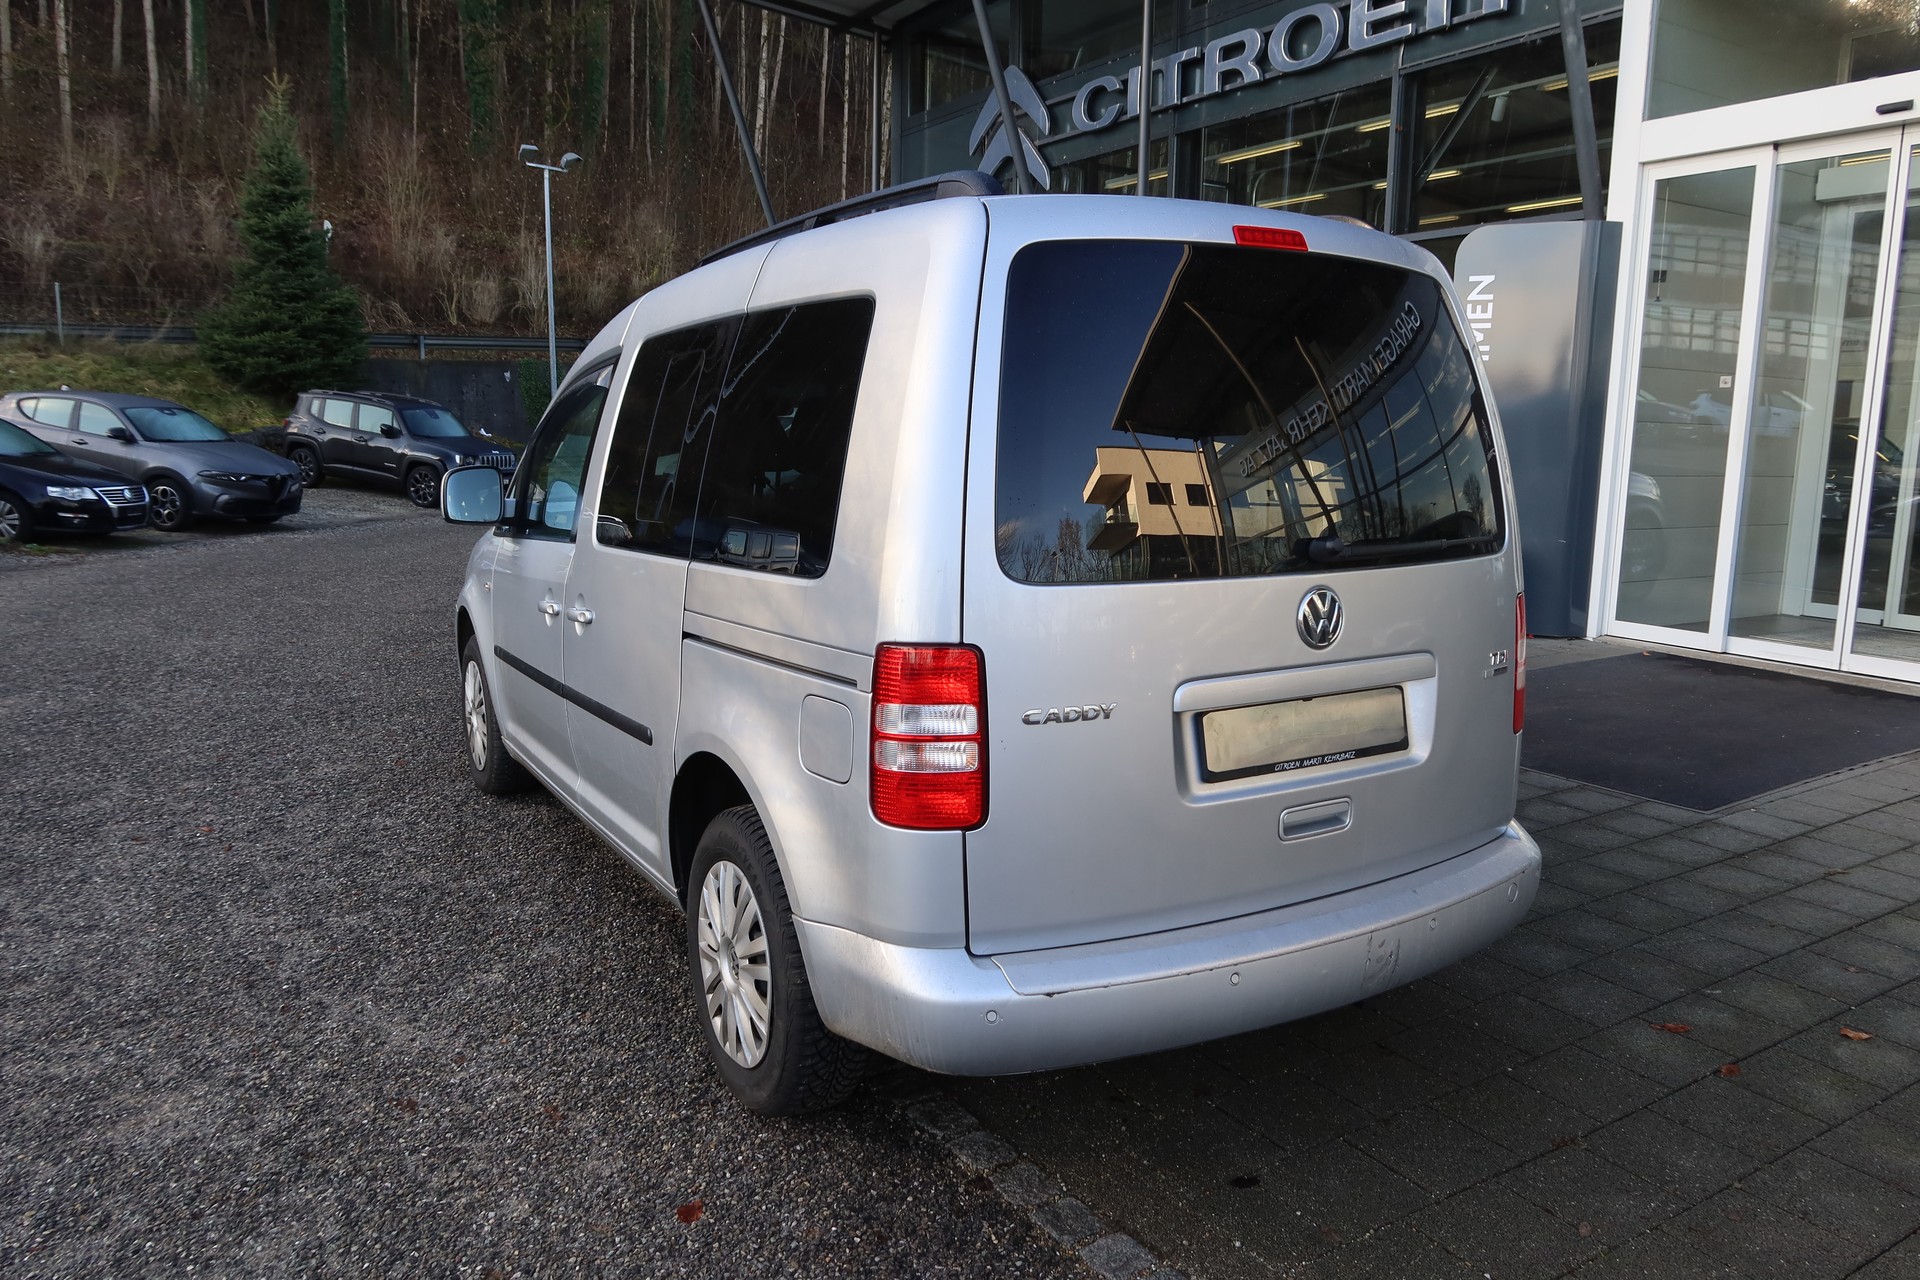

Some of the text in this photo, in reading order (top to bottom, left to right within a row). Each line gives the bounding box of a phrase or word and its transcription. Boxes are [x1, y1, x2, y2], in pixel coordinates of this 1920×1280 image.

[1071, 0, 1507, 131] CITROE
[1022, 702, 1118, 725] CADDY
[1302, 757, 1322, 766] MARTI
[1323, 751, 1356, 763] KEHRSATZ
